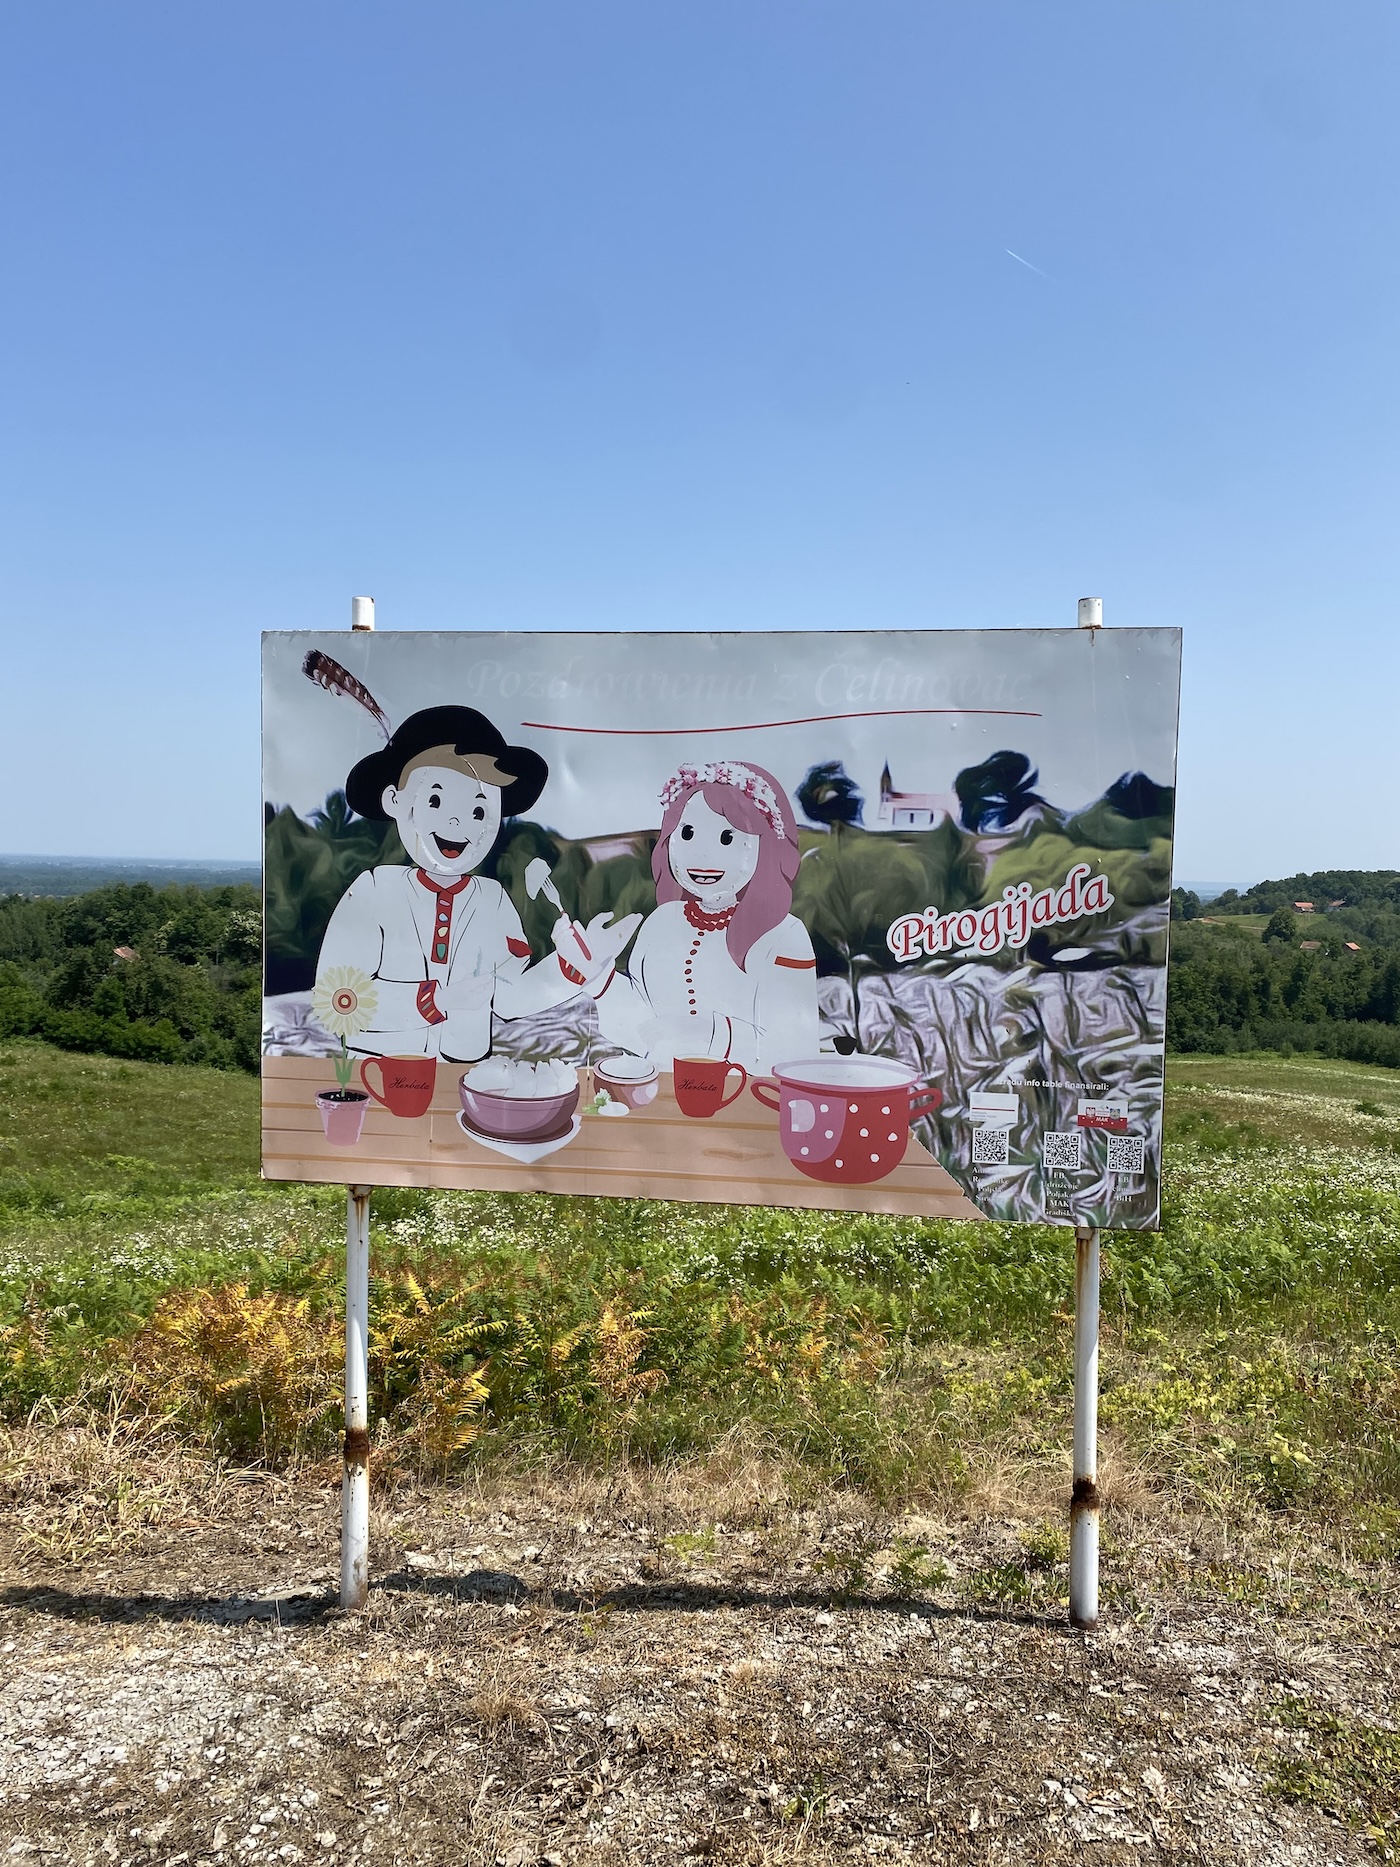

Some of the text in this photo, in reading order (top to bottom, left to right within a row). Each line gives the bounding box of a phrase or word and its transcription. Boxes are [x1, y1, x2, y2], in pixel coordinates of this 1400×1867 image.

[889, 866, 1112, 960] Pirogijada
[389, 1076, 431, 1090] Herbata
[677, 1078, 718, 1092] Herbata
[1024, 1079, 1040, 1087] info
[1042, 1080, 1063, 1089] table
[1064, 1081, 1111, 1091] finansirali:
[1049, 1200, 1070, 1208] MAK
